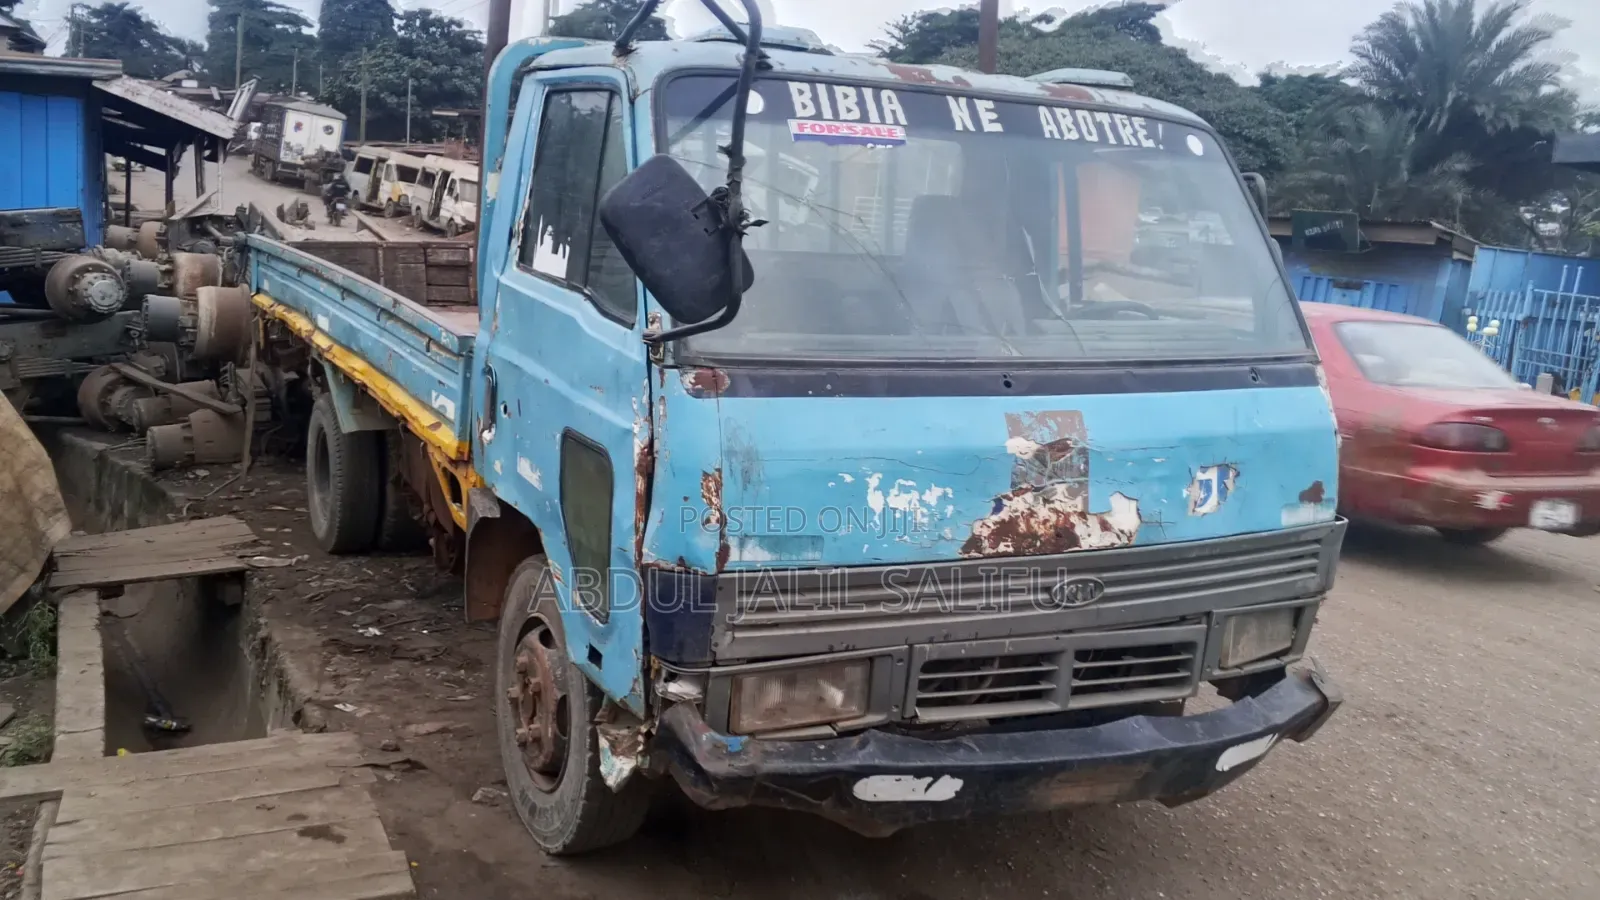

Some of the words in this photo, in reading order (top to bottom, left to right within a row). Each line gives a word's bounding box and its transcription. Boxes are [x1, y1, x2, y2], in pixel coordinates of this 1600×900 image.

[788, 81, 907, 126] BIBIA
[946, 95, 1004, 133] NE
[1037, 105, 1164, 150] ABOTRE!
[797, 122, 840, 134] FOR
[842, 124, 899, 138] SALE
